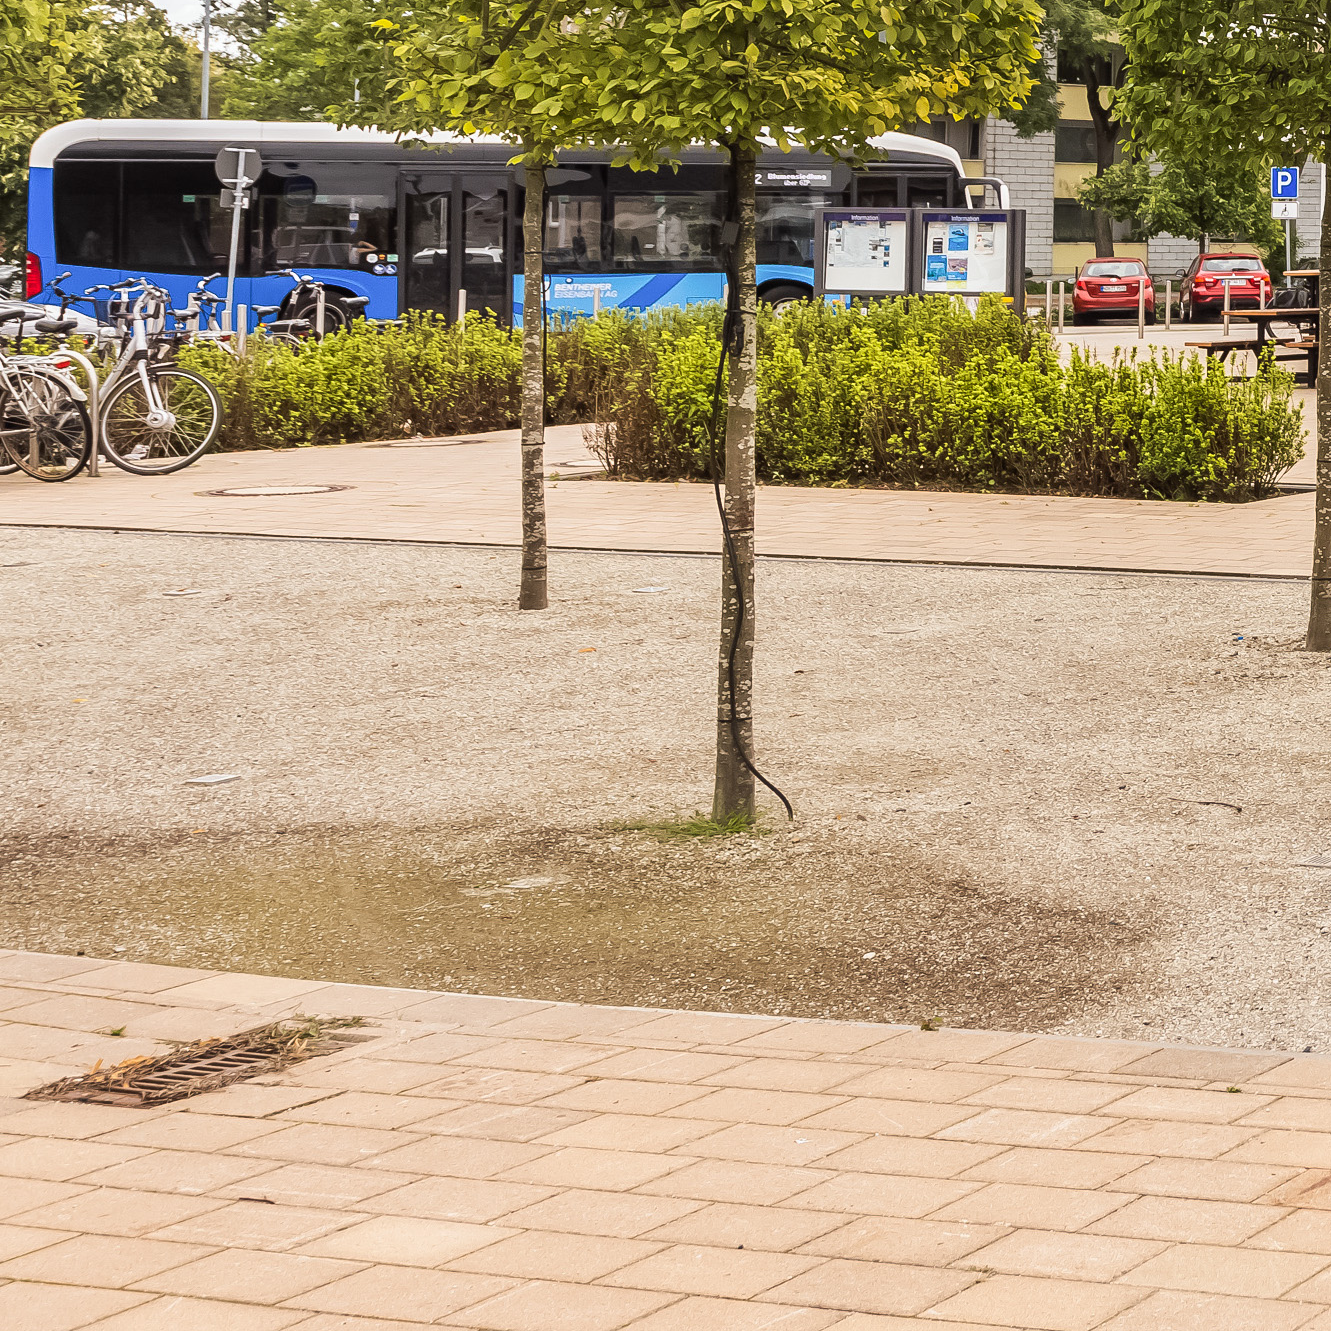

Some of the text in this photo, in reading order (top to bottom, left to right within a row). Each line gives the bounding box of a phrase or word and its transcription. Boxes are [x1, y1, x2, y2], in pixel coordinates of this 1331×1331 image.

[755, 173, 763, 185] 2
[1277, 171, 1292, 195] P
[554, 283, 612, 291] BENTHEIMER
[605, 290, 618, 298] AG
